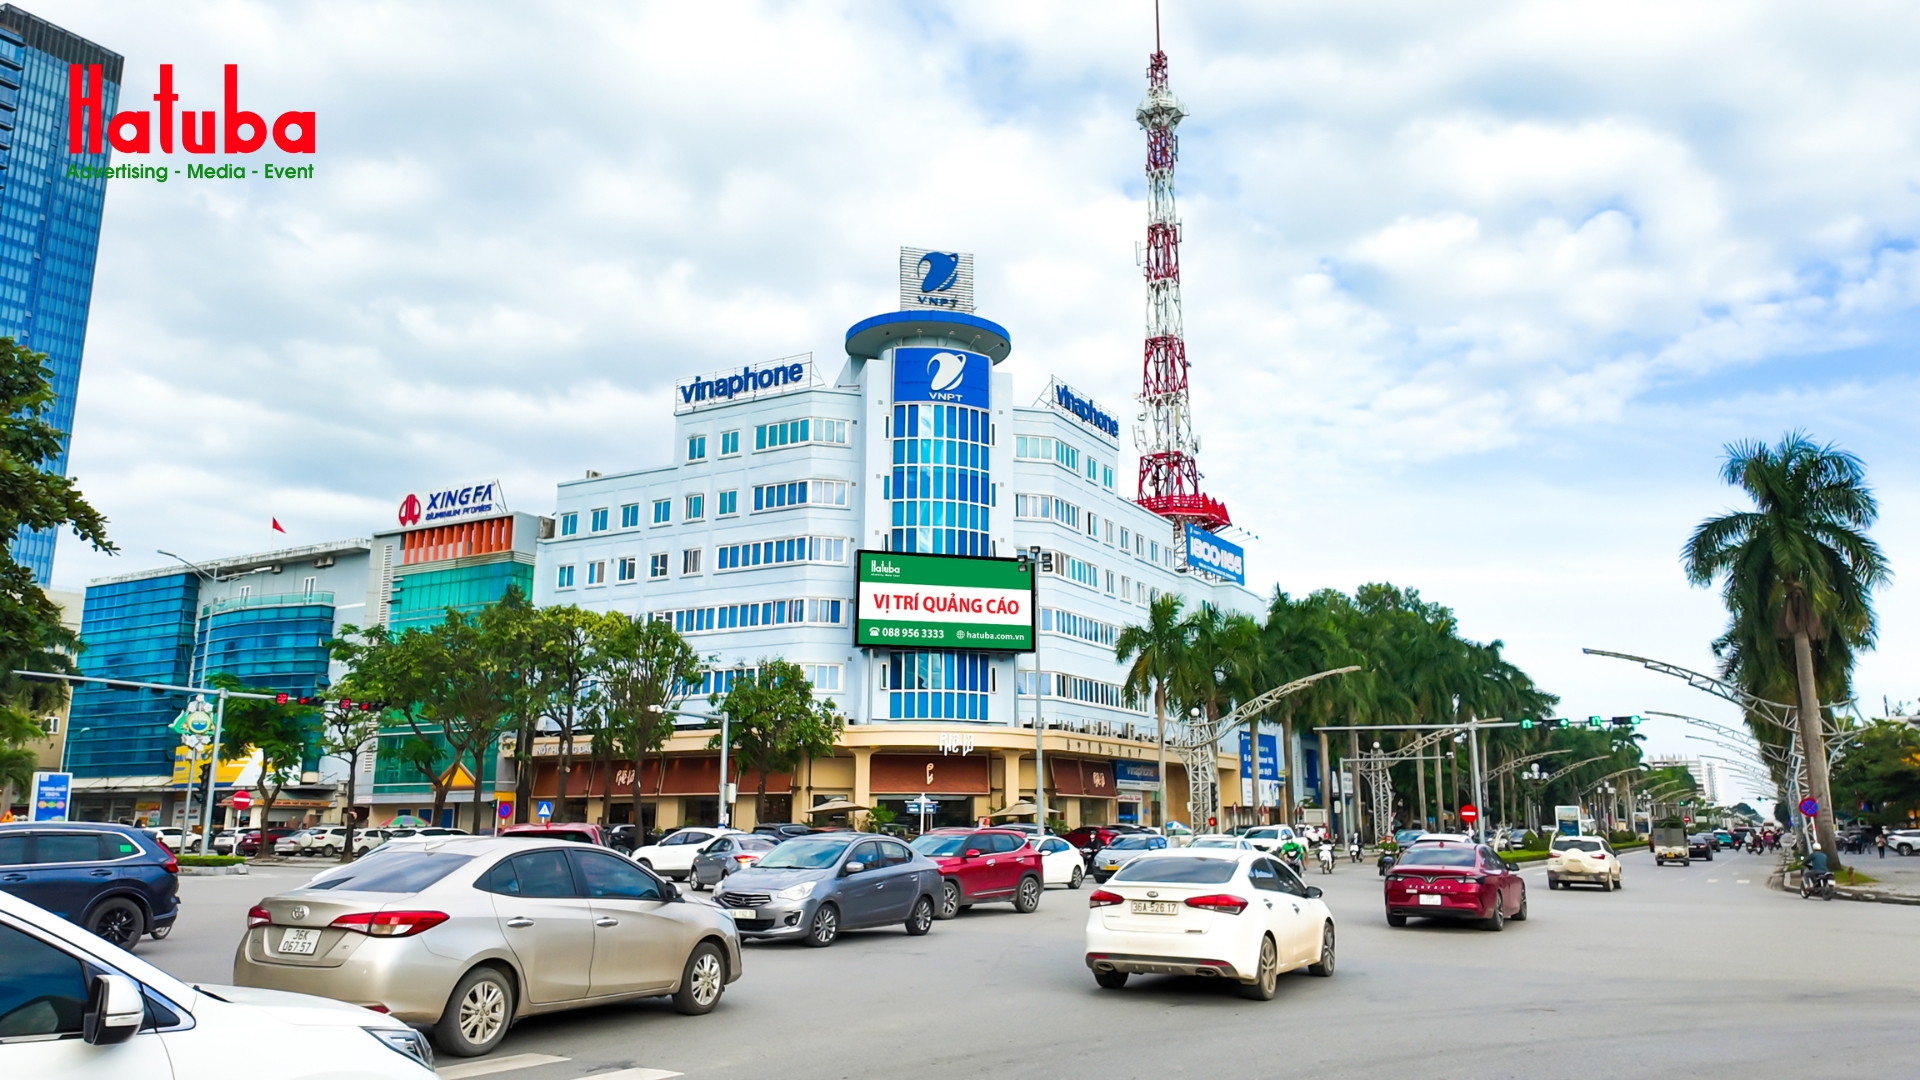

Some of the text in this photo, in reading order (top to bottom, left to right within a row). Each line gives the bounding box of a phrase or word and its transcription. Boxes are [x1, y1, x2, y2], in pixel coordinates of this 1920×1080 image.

[917, 295, 958, 307] VNPT
[681, 363, 803, 403] vinaphone
[928, 391, 963, 402] VNPT
[871, 559, 900, 574] Hatuba
[873, 592, 1020, 615] VỊ TRÍ QUẢNG CÁO
[882, 627, 945, 640] 088 956 3333
[966, 630, 1025, 641] hatuba.com.vn
[293, 929, 311, 940] 36K
[282, 941, 312, 953] 067.57
